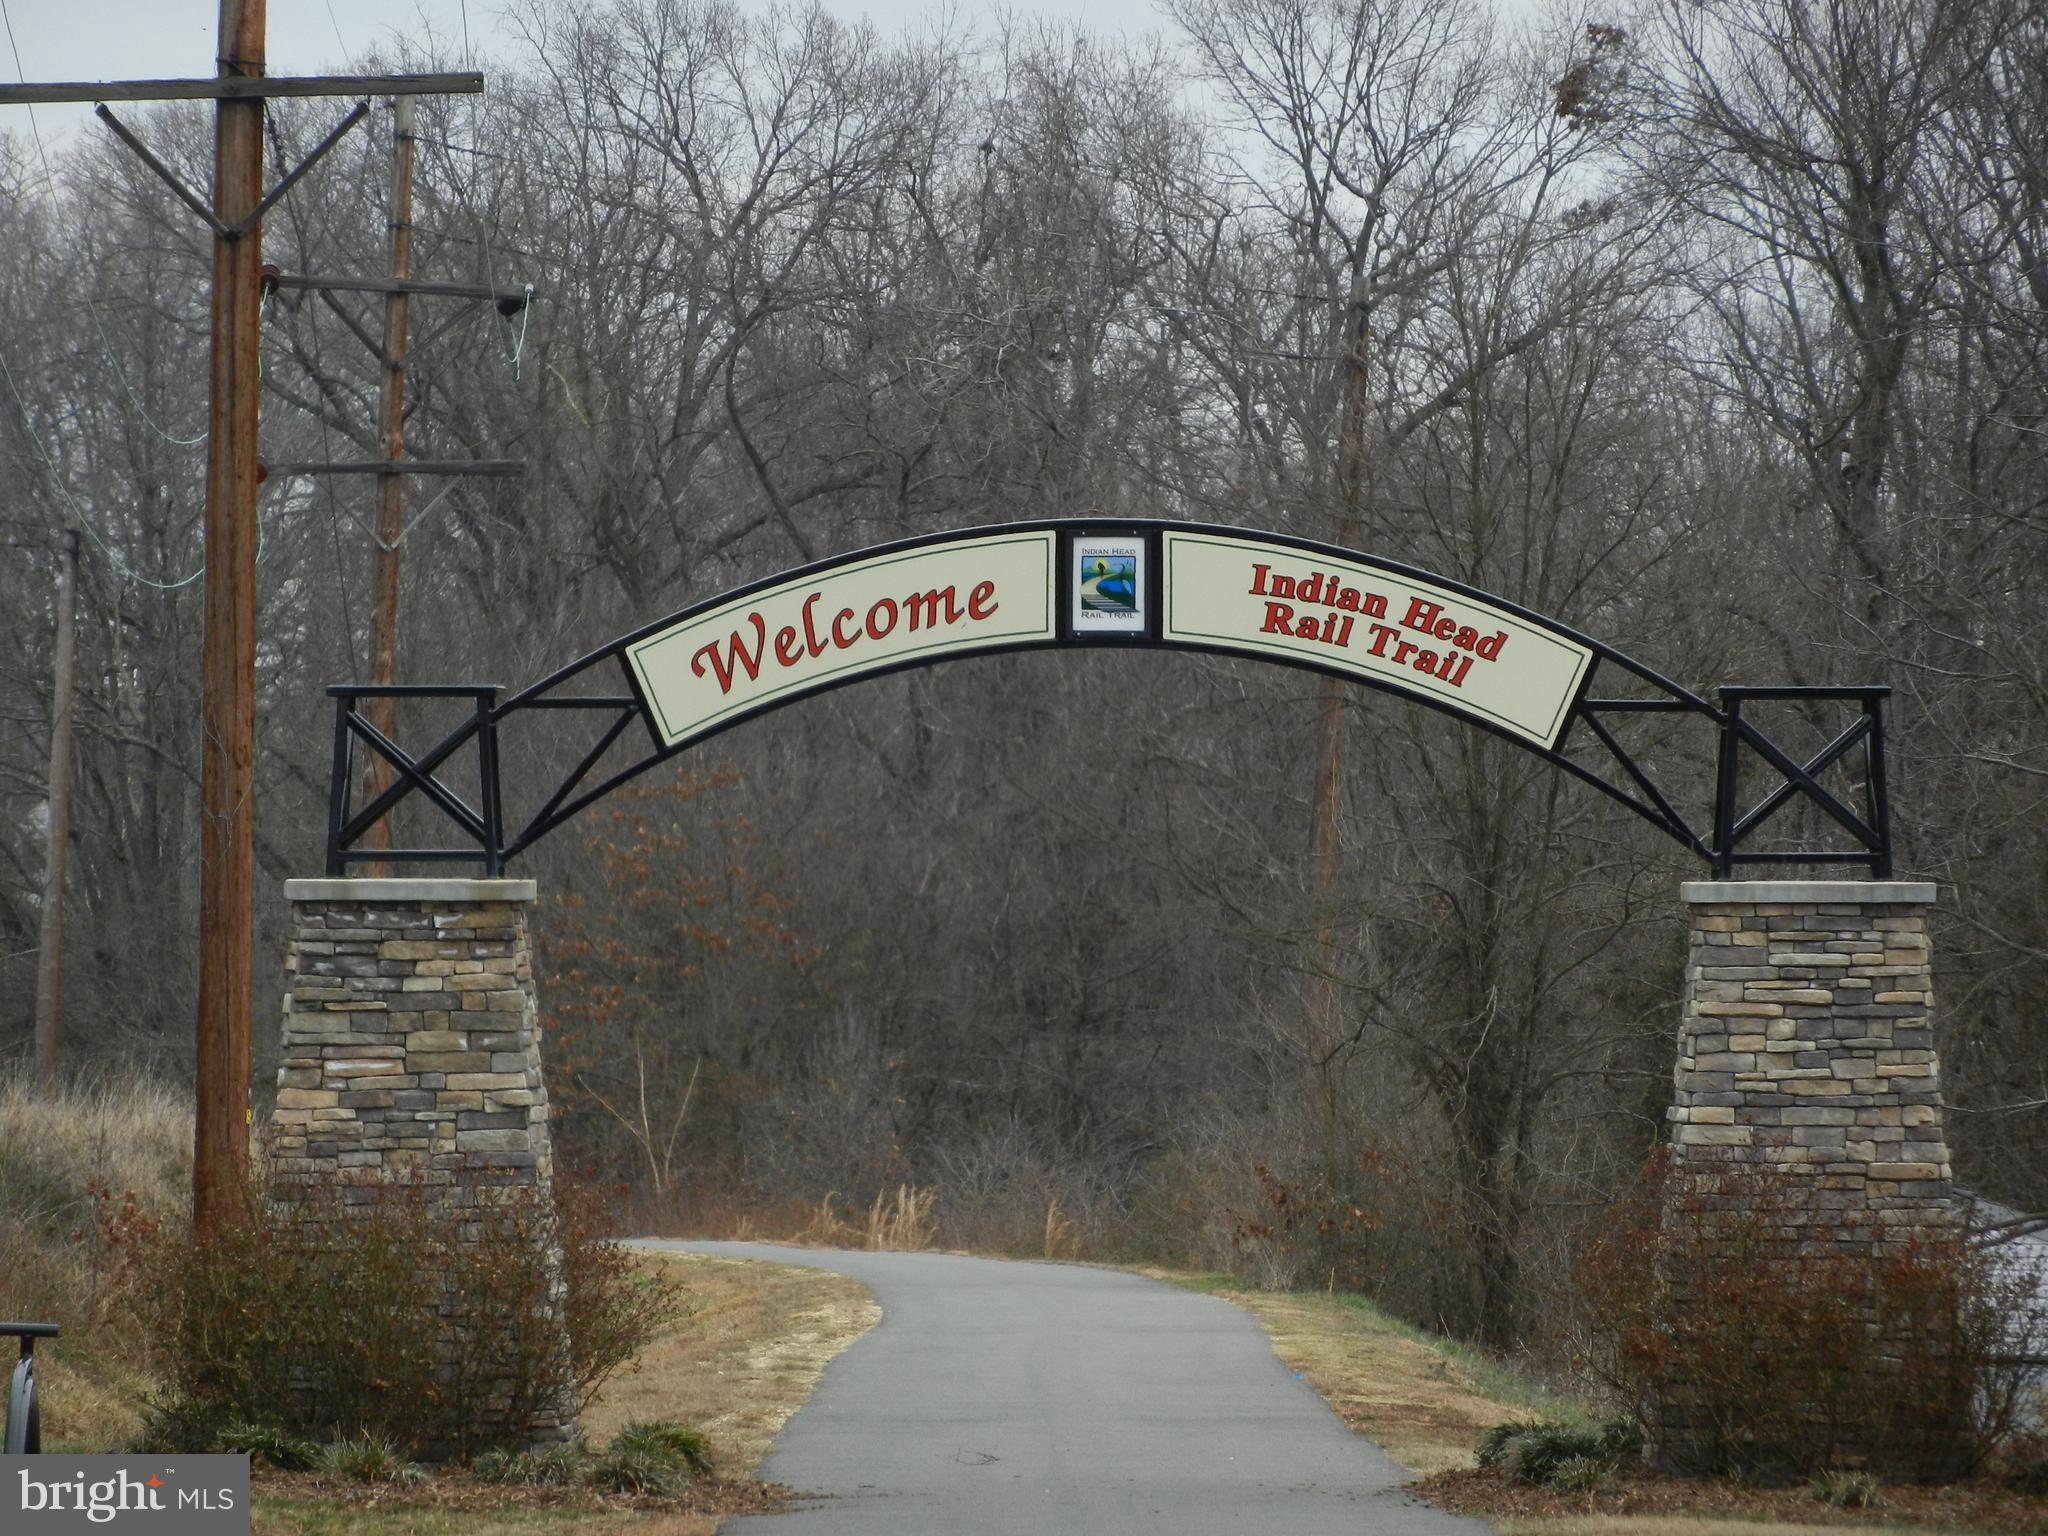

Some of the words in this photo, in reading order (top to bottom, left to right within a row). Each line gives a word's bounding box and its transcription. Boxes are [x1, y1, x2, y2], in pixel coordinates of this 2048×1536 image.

[690, 580, 999, 695] Welcome
[1081, 611, 1104, 619] RAIL
[1107, 611, 1135, 619] TRAIL
[1249, 563, 1389, 619] Indian
[1399, 596, 1509, 662] Head
[1259, 601, 1354, 648] Rail
[1366, 623, 1474, 688] Trail
